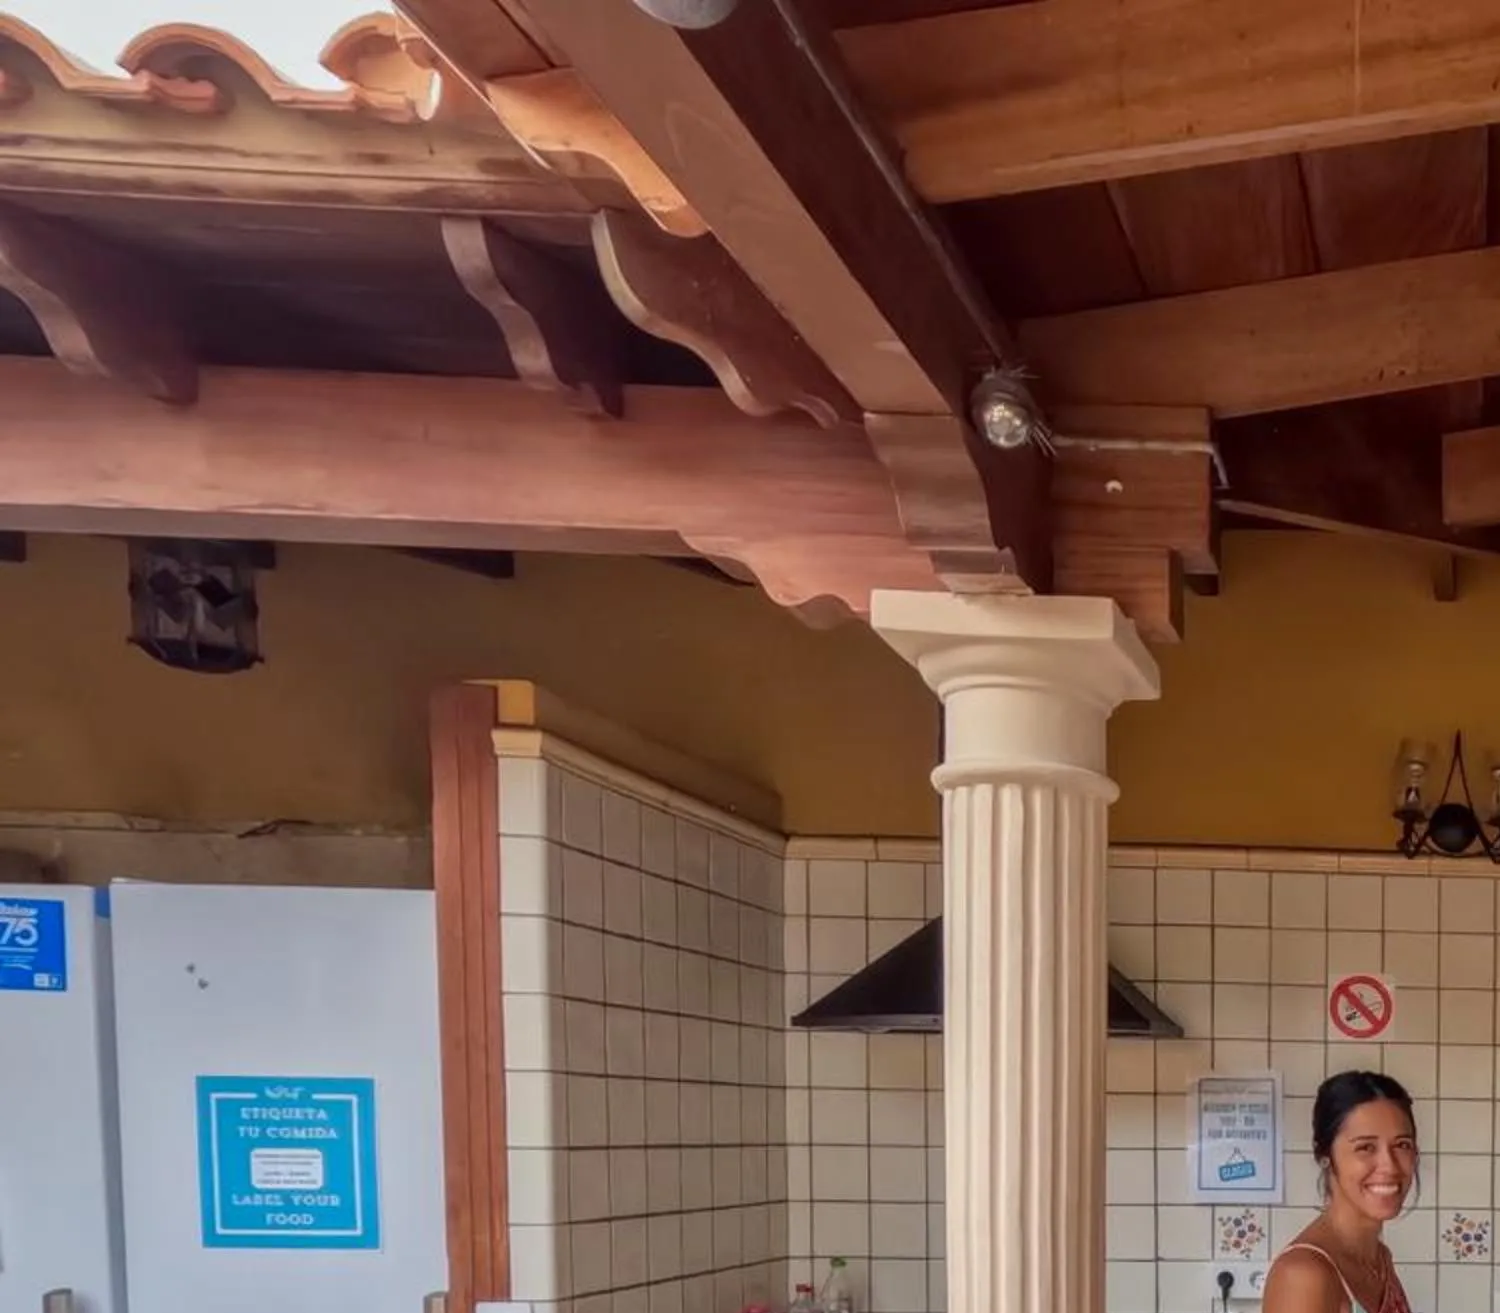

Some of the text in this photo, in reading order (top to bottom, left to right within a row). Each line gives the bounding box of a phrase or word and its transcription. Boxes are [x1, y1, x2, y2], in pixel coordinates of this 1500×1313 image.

[240, 1107, 328, 1121] ETIQUETA
[238, 1125, 338, 1139] TU COMIDA
[231, 1193, 341, 1207] LABEL YOUR
[265, 1212, 314, 1226] FOOD
